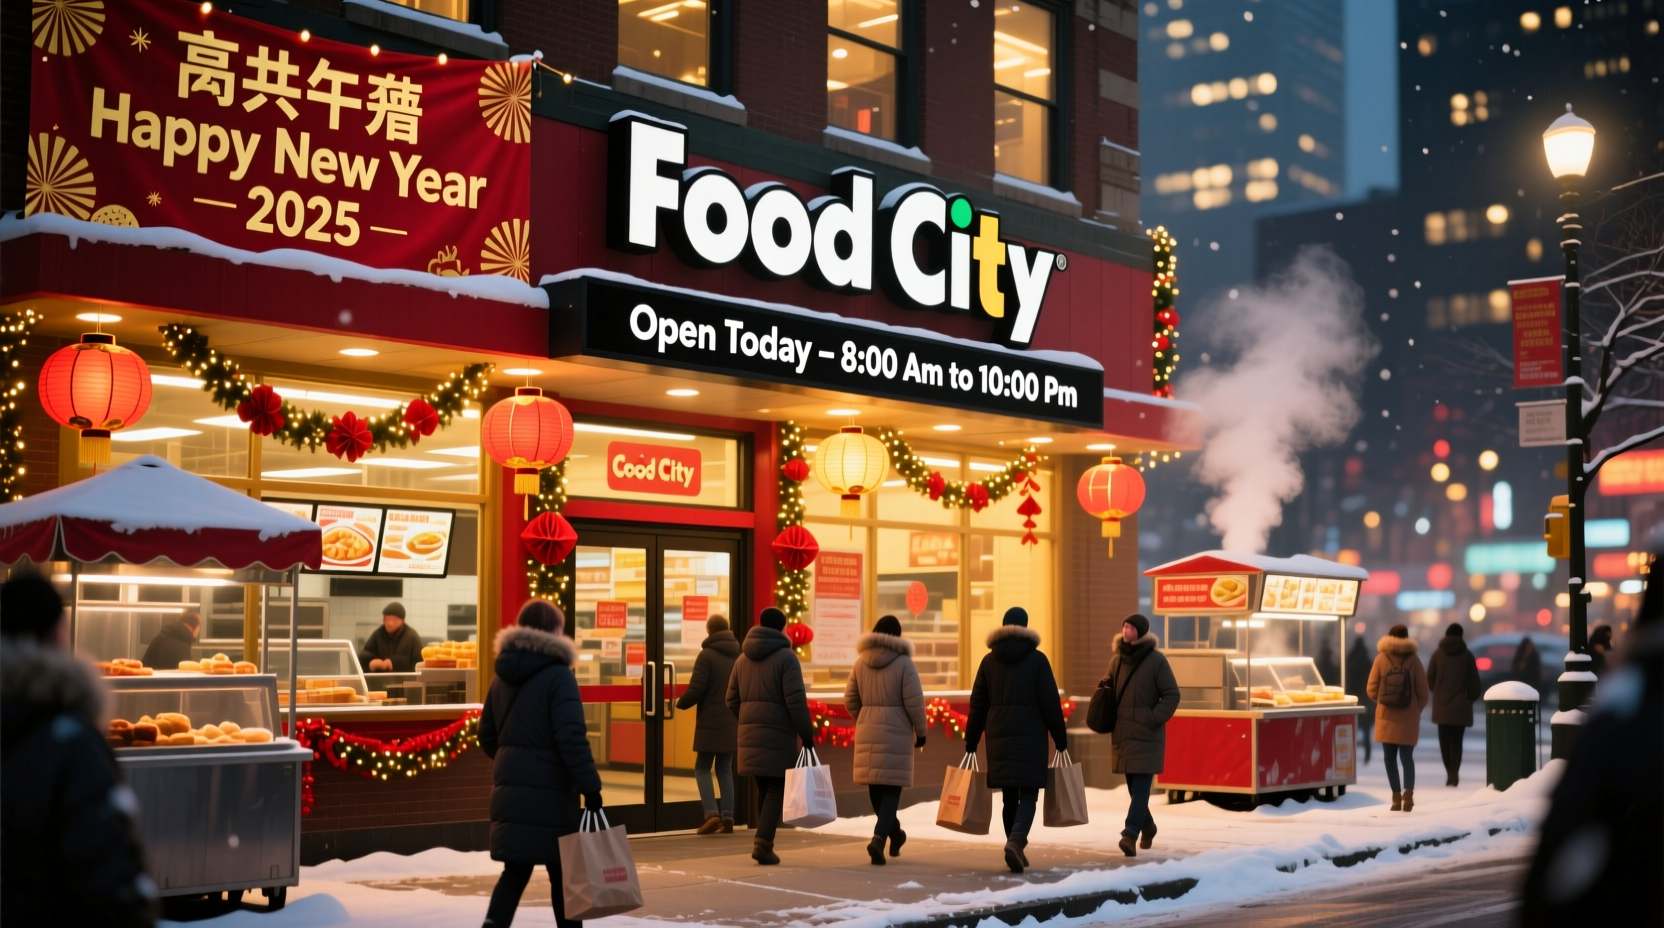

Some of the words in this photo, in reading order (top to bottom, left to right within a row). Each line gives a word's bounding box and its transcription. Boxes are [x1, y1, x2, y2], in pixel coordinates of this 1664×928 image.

[90, 87, 262, 180] Happy
[274, 127, 380, 191] New
[386, 150, 488, 209] Year
[245, 185, 361, 247] 2025
[628, 120, 873, 291] Food
[629, 303, 717, 353] Open
[724, 318, 813, 374] Today
[840, 340, 898, 380] 8:00
[902, 351, 944, 387] Am
[948, 361, 974, 392] to
[978, 364, 1040, 402] 10:00
[1044, 375, 1078, 408] Pm
[658, 457, 695, 488] City
